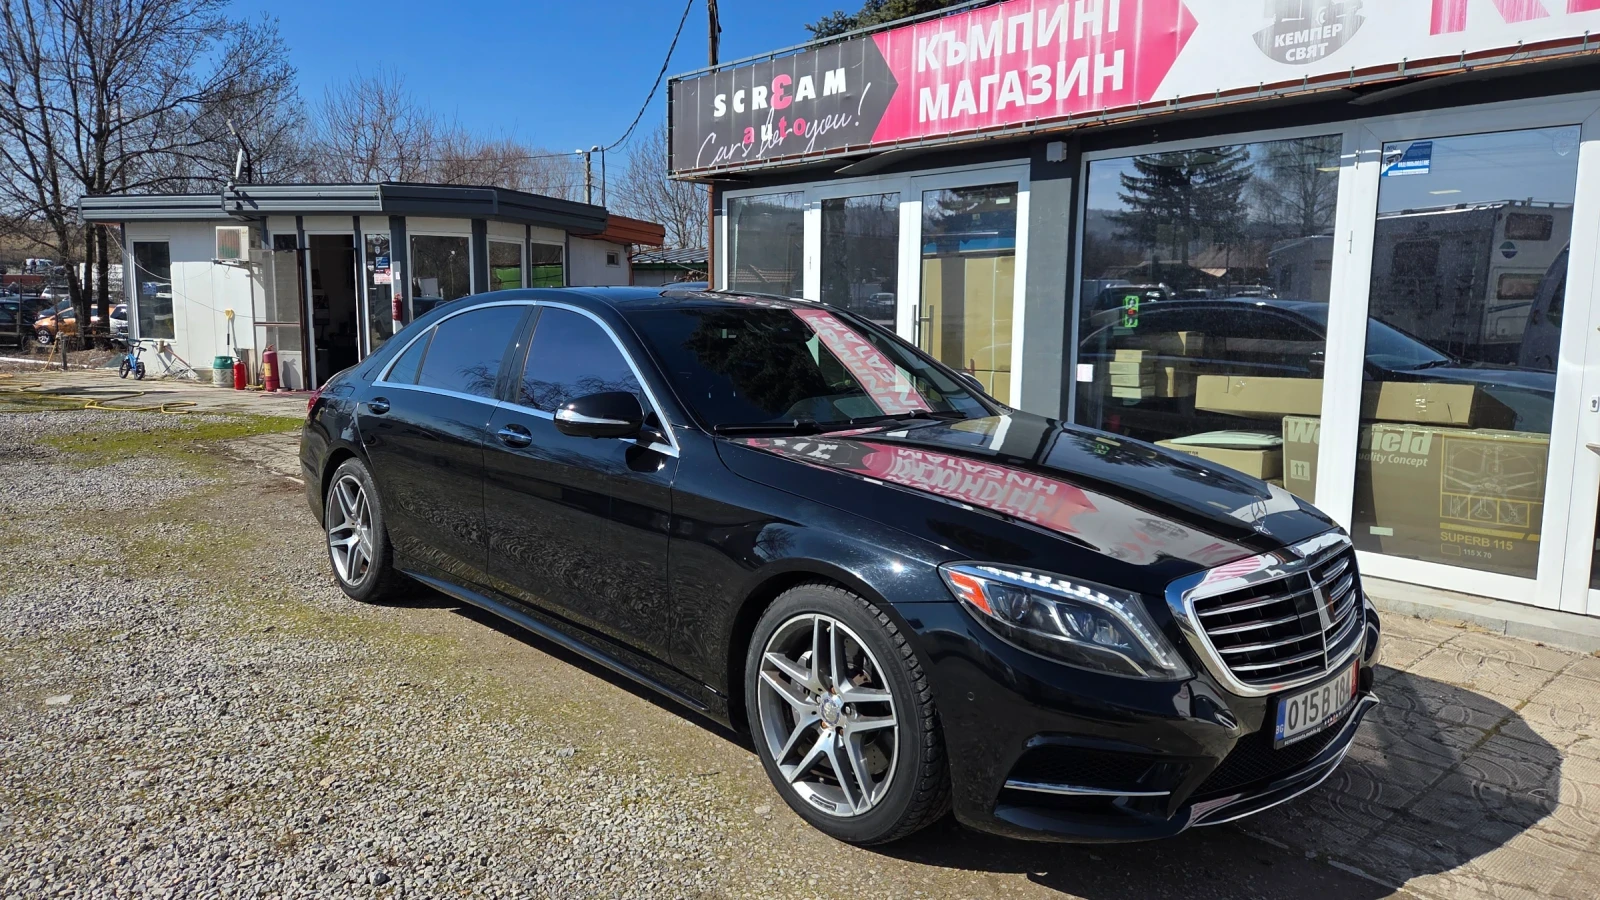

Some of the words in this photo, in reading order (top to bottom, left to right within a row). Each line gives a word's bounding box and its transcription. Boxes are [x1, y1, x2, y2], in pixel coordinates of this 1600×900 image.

[1274, 23, 1343, 48] КЕМПЕР
[1285, 42, 1329, 62] СВЯТ
[919, 49, 1125, 123] МАГАЗИН
[743, 115, 806, 145] auto
[696, 131, 753, 168] Cars
[1358, 451, 1387, 465] uality
[1388, 453, 1429, 468] Concept
[1440, 531, 1490, 548] SUPERB
[1493, 539, 1513, 551] 115
[1463, 548, 1475, 557] 115
[1483, 551, 1492, 559] 70
[1275, 723, 1284, 735] BG
